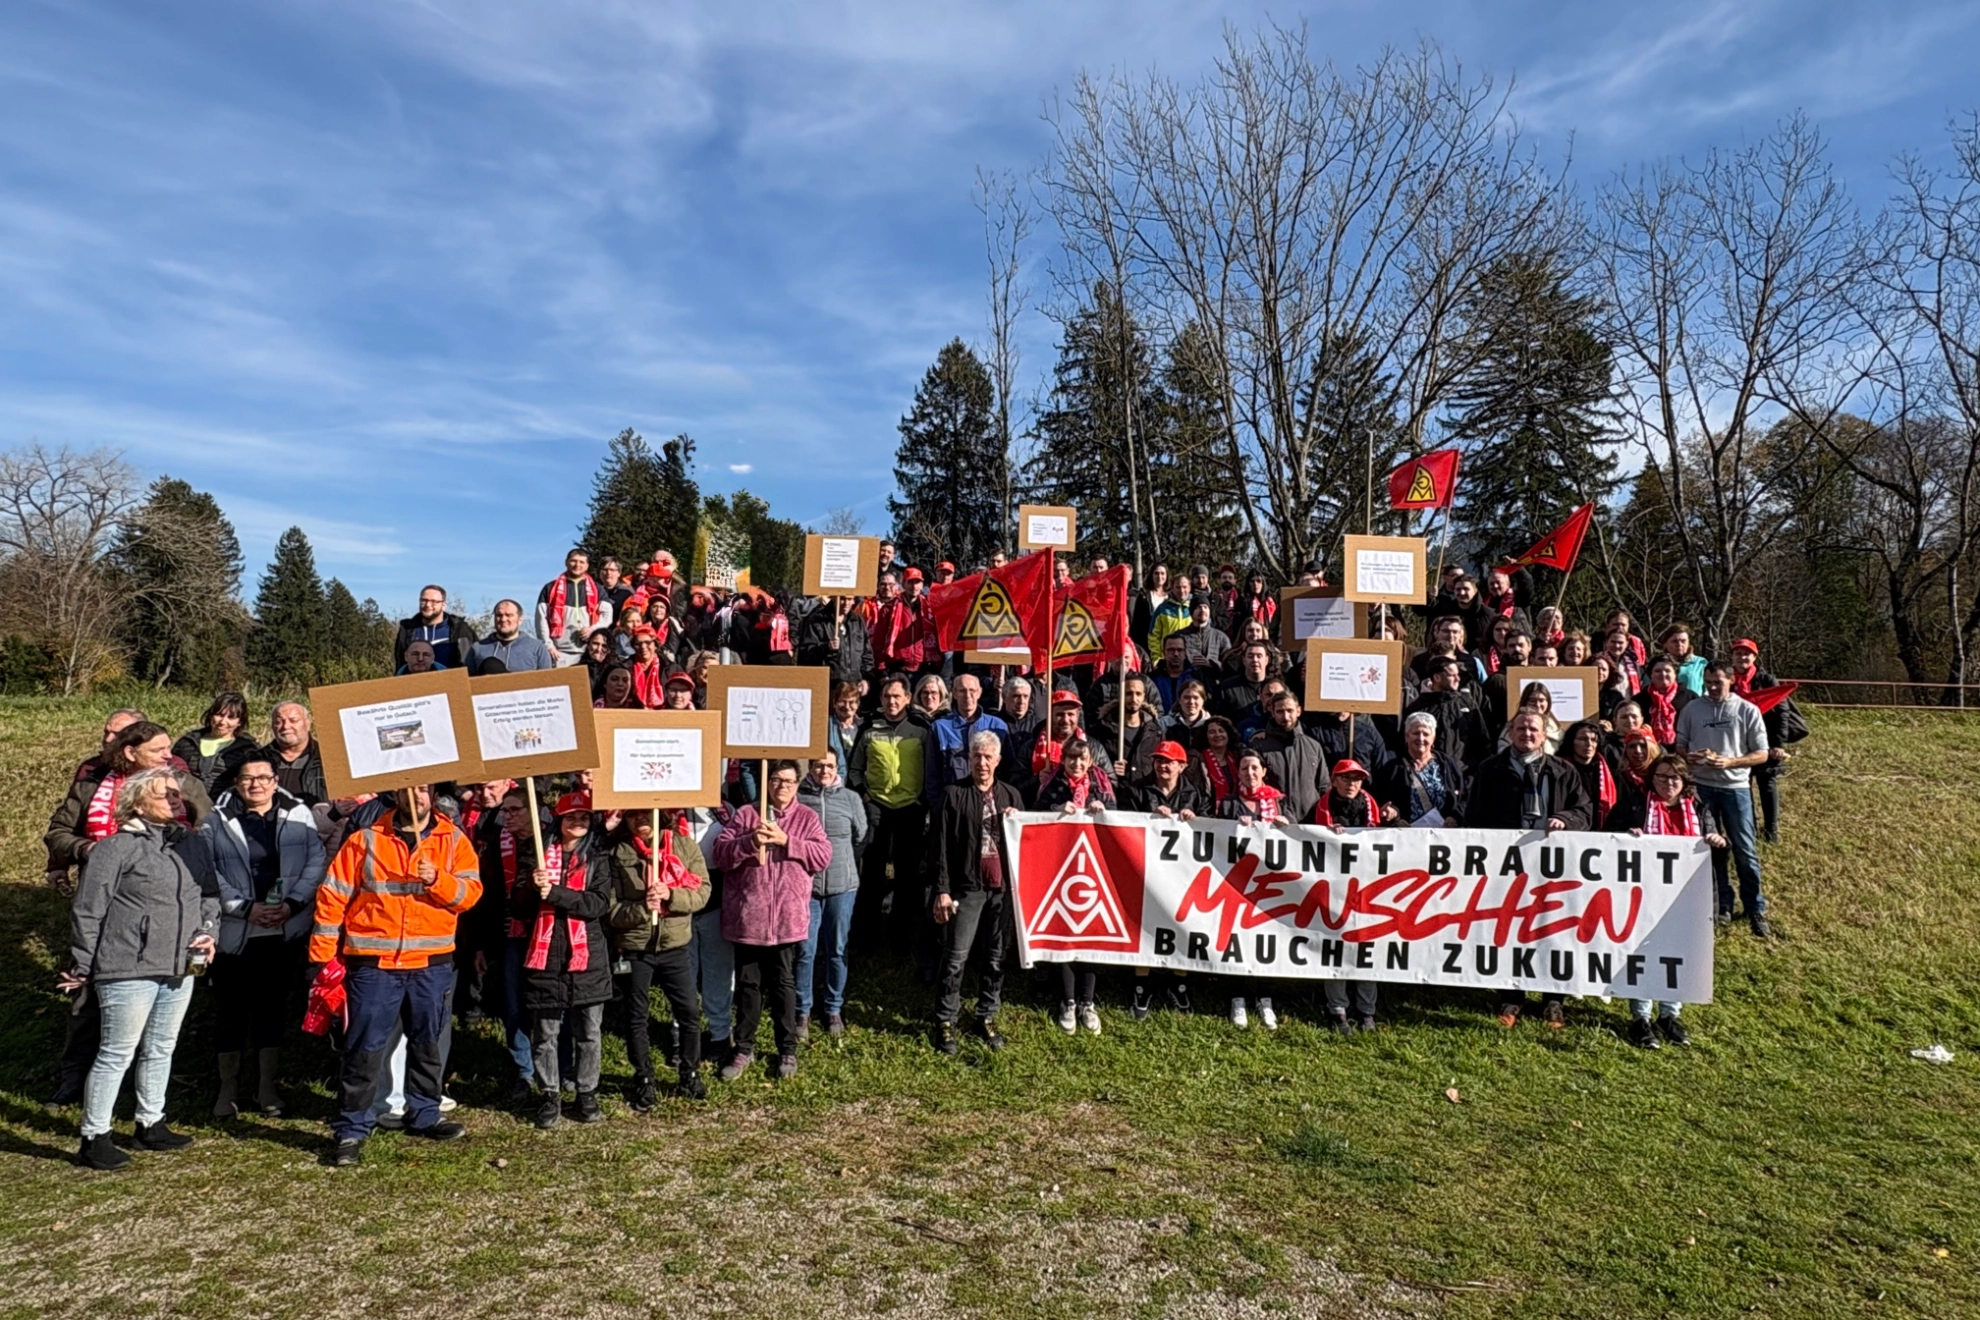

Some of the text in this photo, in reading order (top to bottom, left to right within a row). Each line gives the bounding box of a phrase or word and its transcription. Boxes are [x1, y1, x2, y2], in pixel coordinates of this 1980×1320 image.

[388, 702, 412, 711] Qualität
[1160, 830, 1680, 884] ZUKUNFT BRAUCHT
[1175, 853, 1642, 952] MENSCHEN
[1154, 927, 1684, 989] BRAUCHEN ZUKUNFT
